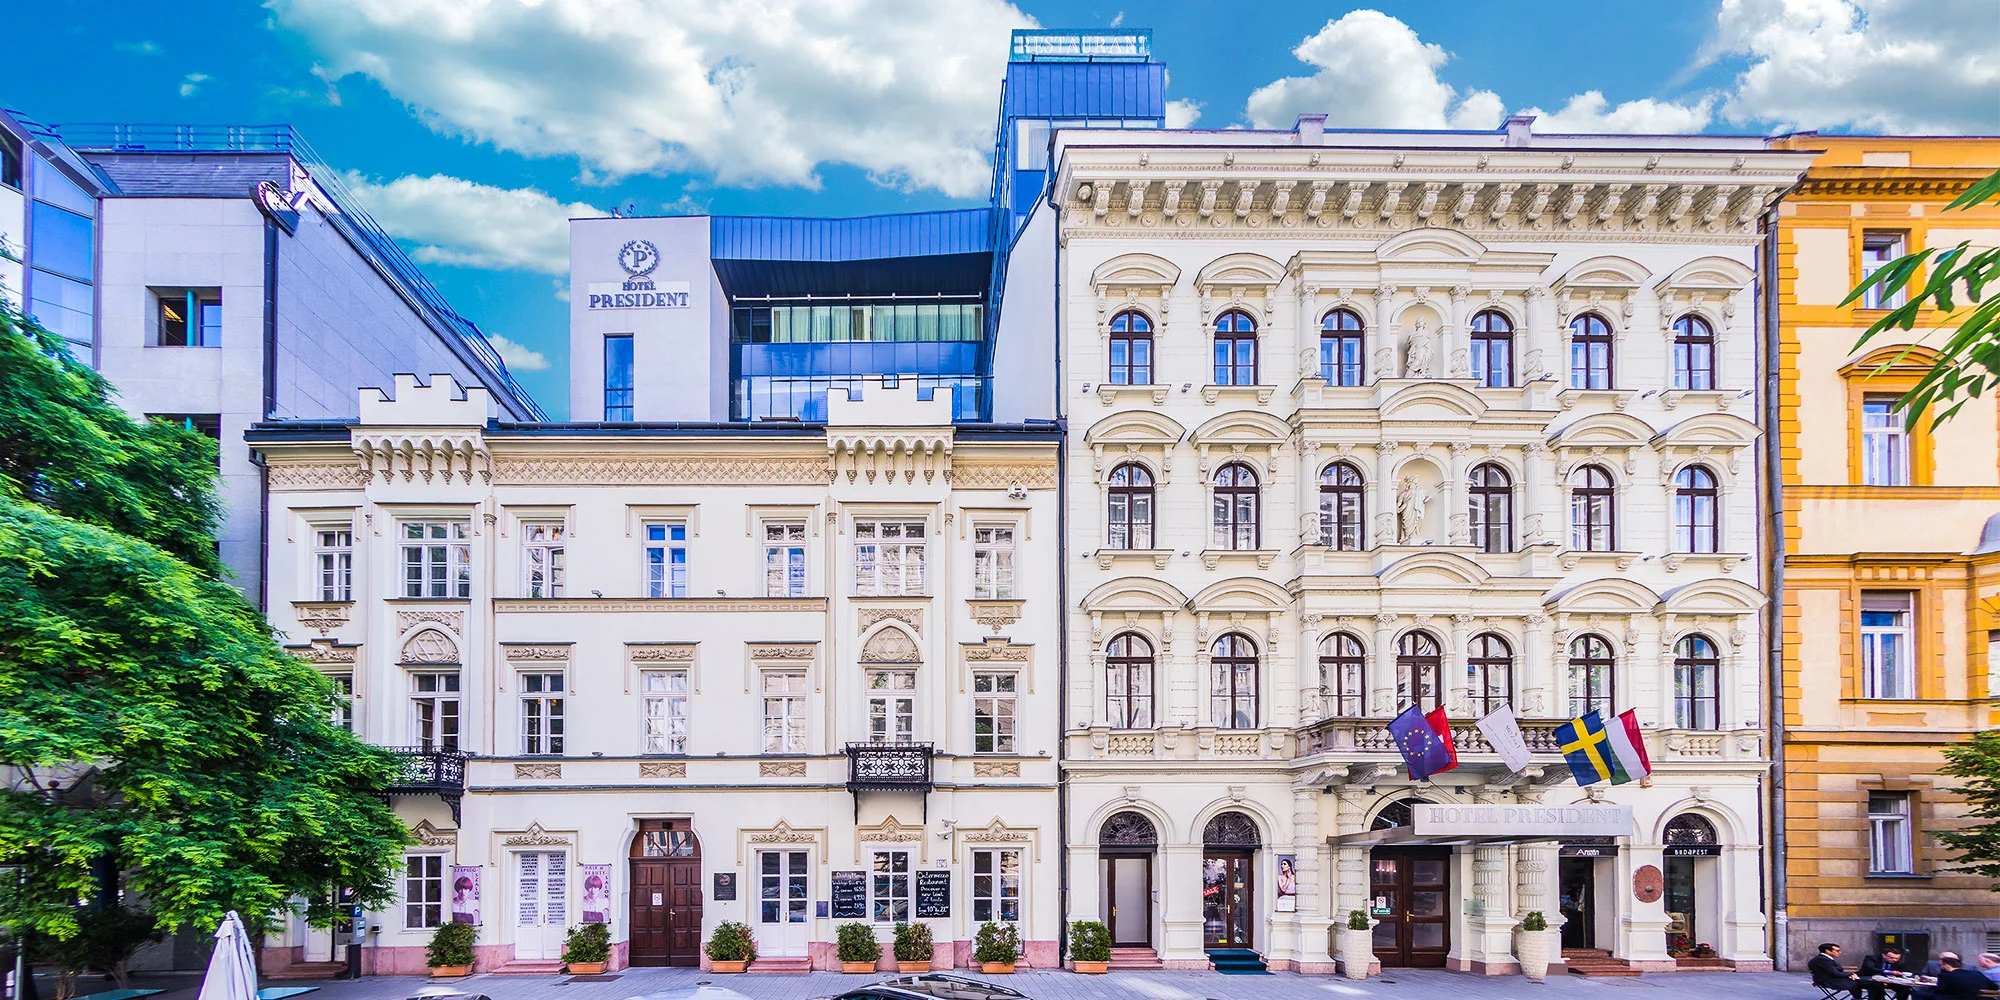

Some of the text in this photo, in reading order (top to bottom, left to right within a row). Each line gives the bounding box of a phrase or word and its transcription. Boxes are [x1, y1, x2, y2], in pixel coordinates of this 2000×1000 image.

[1019, 35, 1148, 54] RESTAURANT
[632, 250, 648, 268] P
[622, 281, 657, 291] HOTEL
[588, 292, 689, 308] PRESIDENT
[1428, 807, 1622, 824] HOTEL PRESIDENT
[354, 906, 361, 915] P
